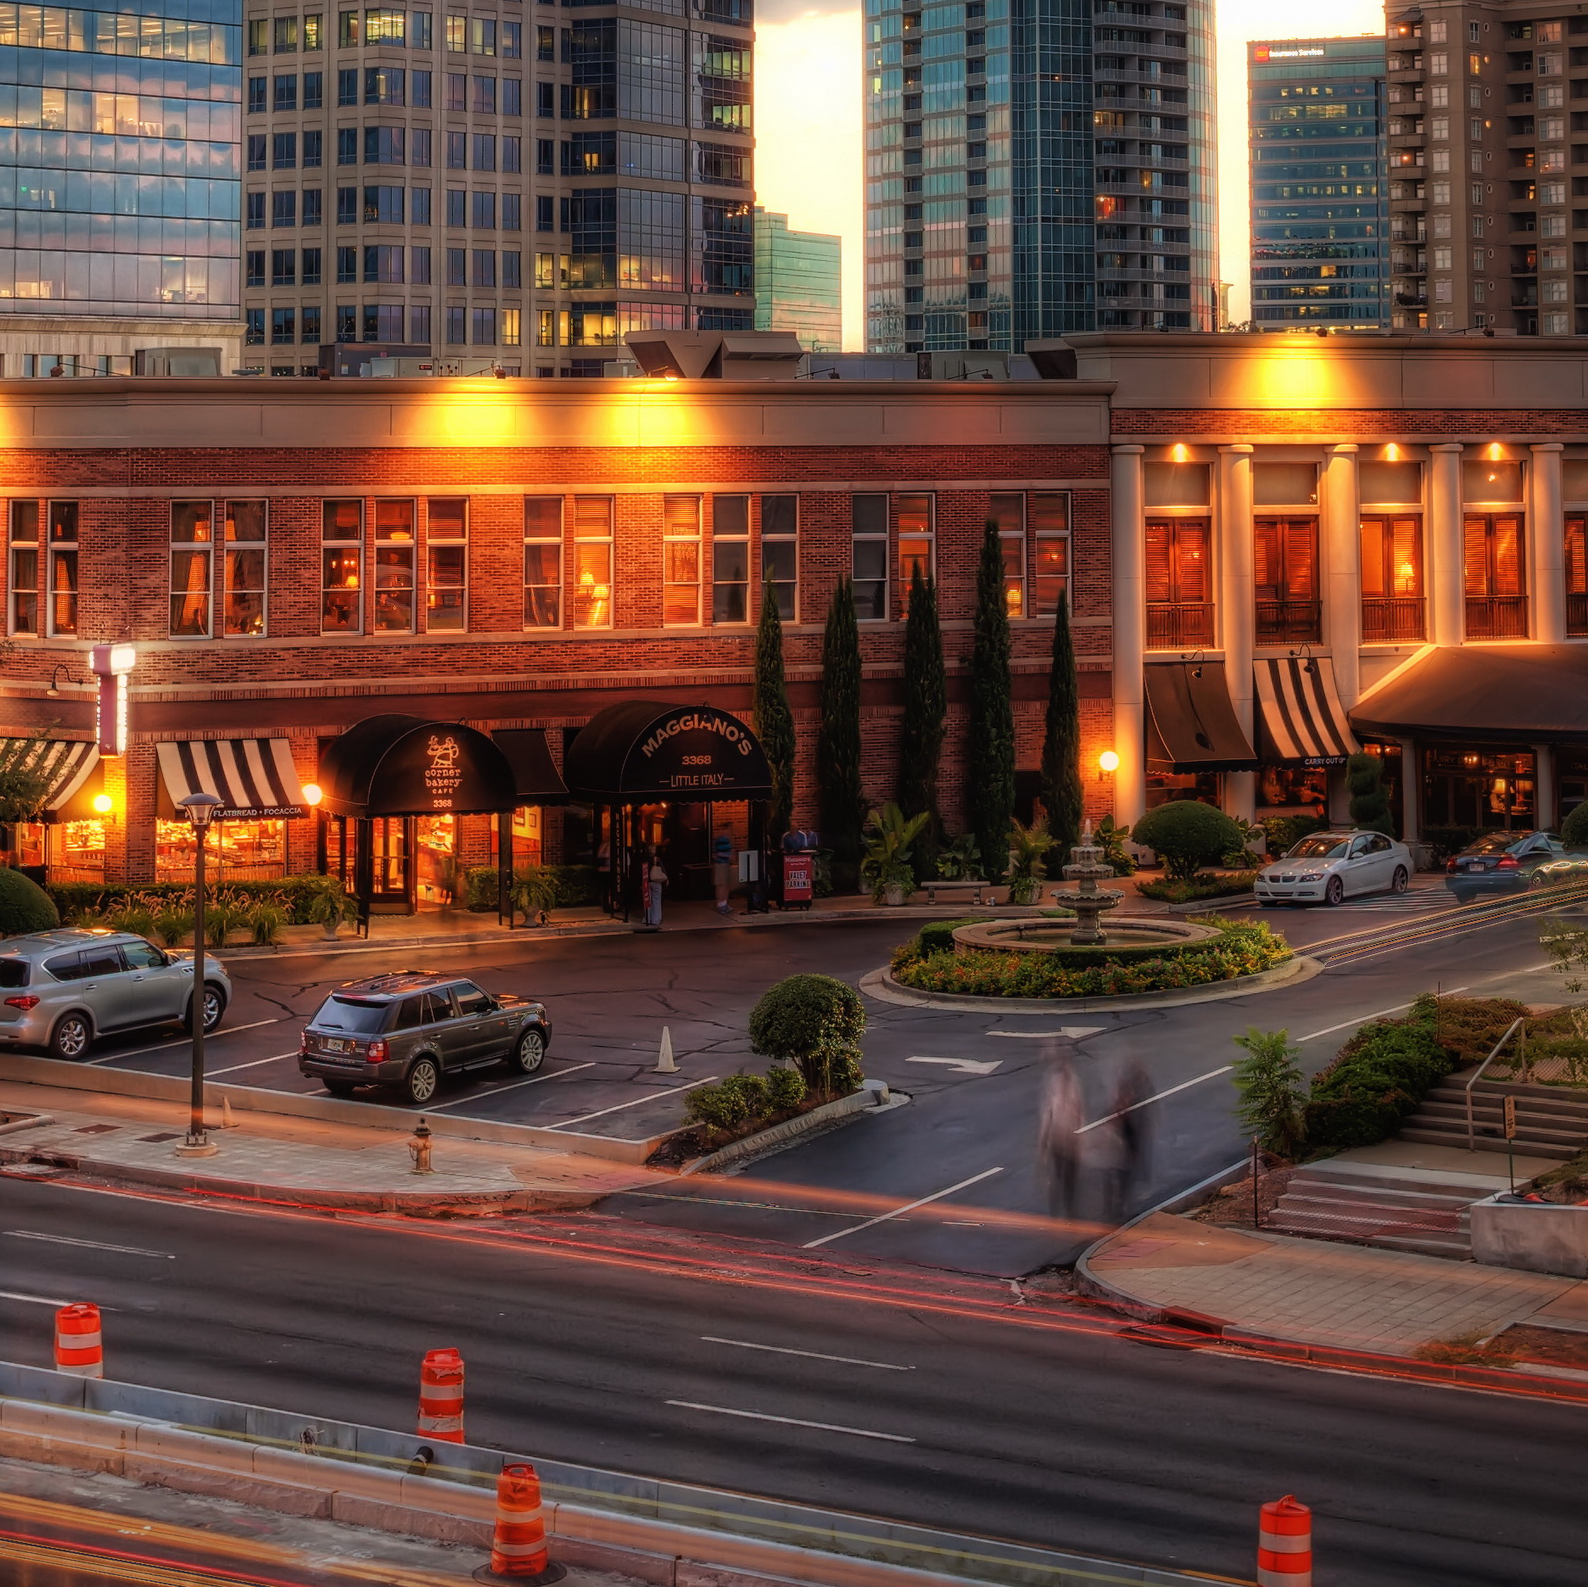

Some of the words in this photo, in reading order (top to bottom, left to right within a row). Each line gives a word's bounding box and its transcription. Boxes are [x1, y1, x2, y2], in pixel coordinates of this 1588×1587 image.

[641, 713, 753, 758] MAGGIANO'S
[681, 755, 712, 765] 3368
[1304, 757, 1325, 766] CARRY
[1325, 756, 1339, 765] OUT
[424, 769, 461, 777] corner
[425, 778, 462, 788] bakery
[671, 775, 699, 788] LITTLE
[701, 773, 724, 785] ITALY
[433, 799, 453, 808] 3368
[213, 809, 258, 818] FLATBREAD
[263, 807, 302, 816] FOCACCIA
